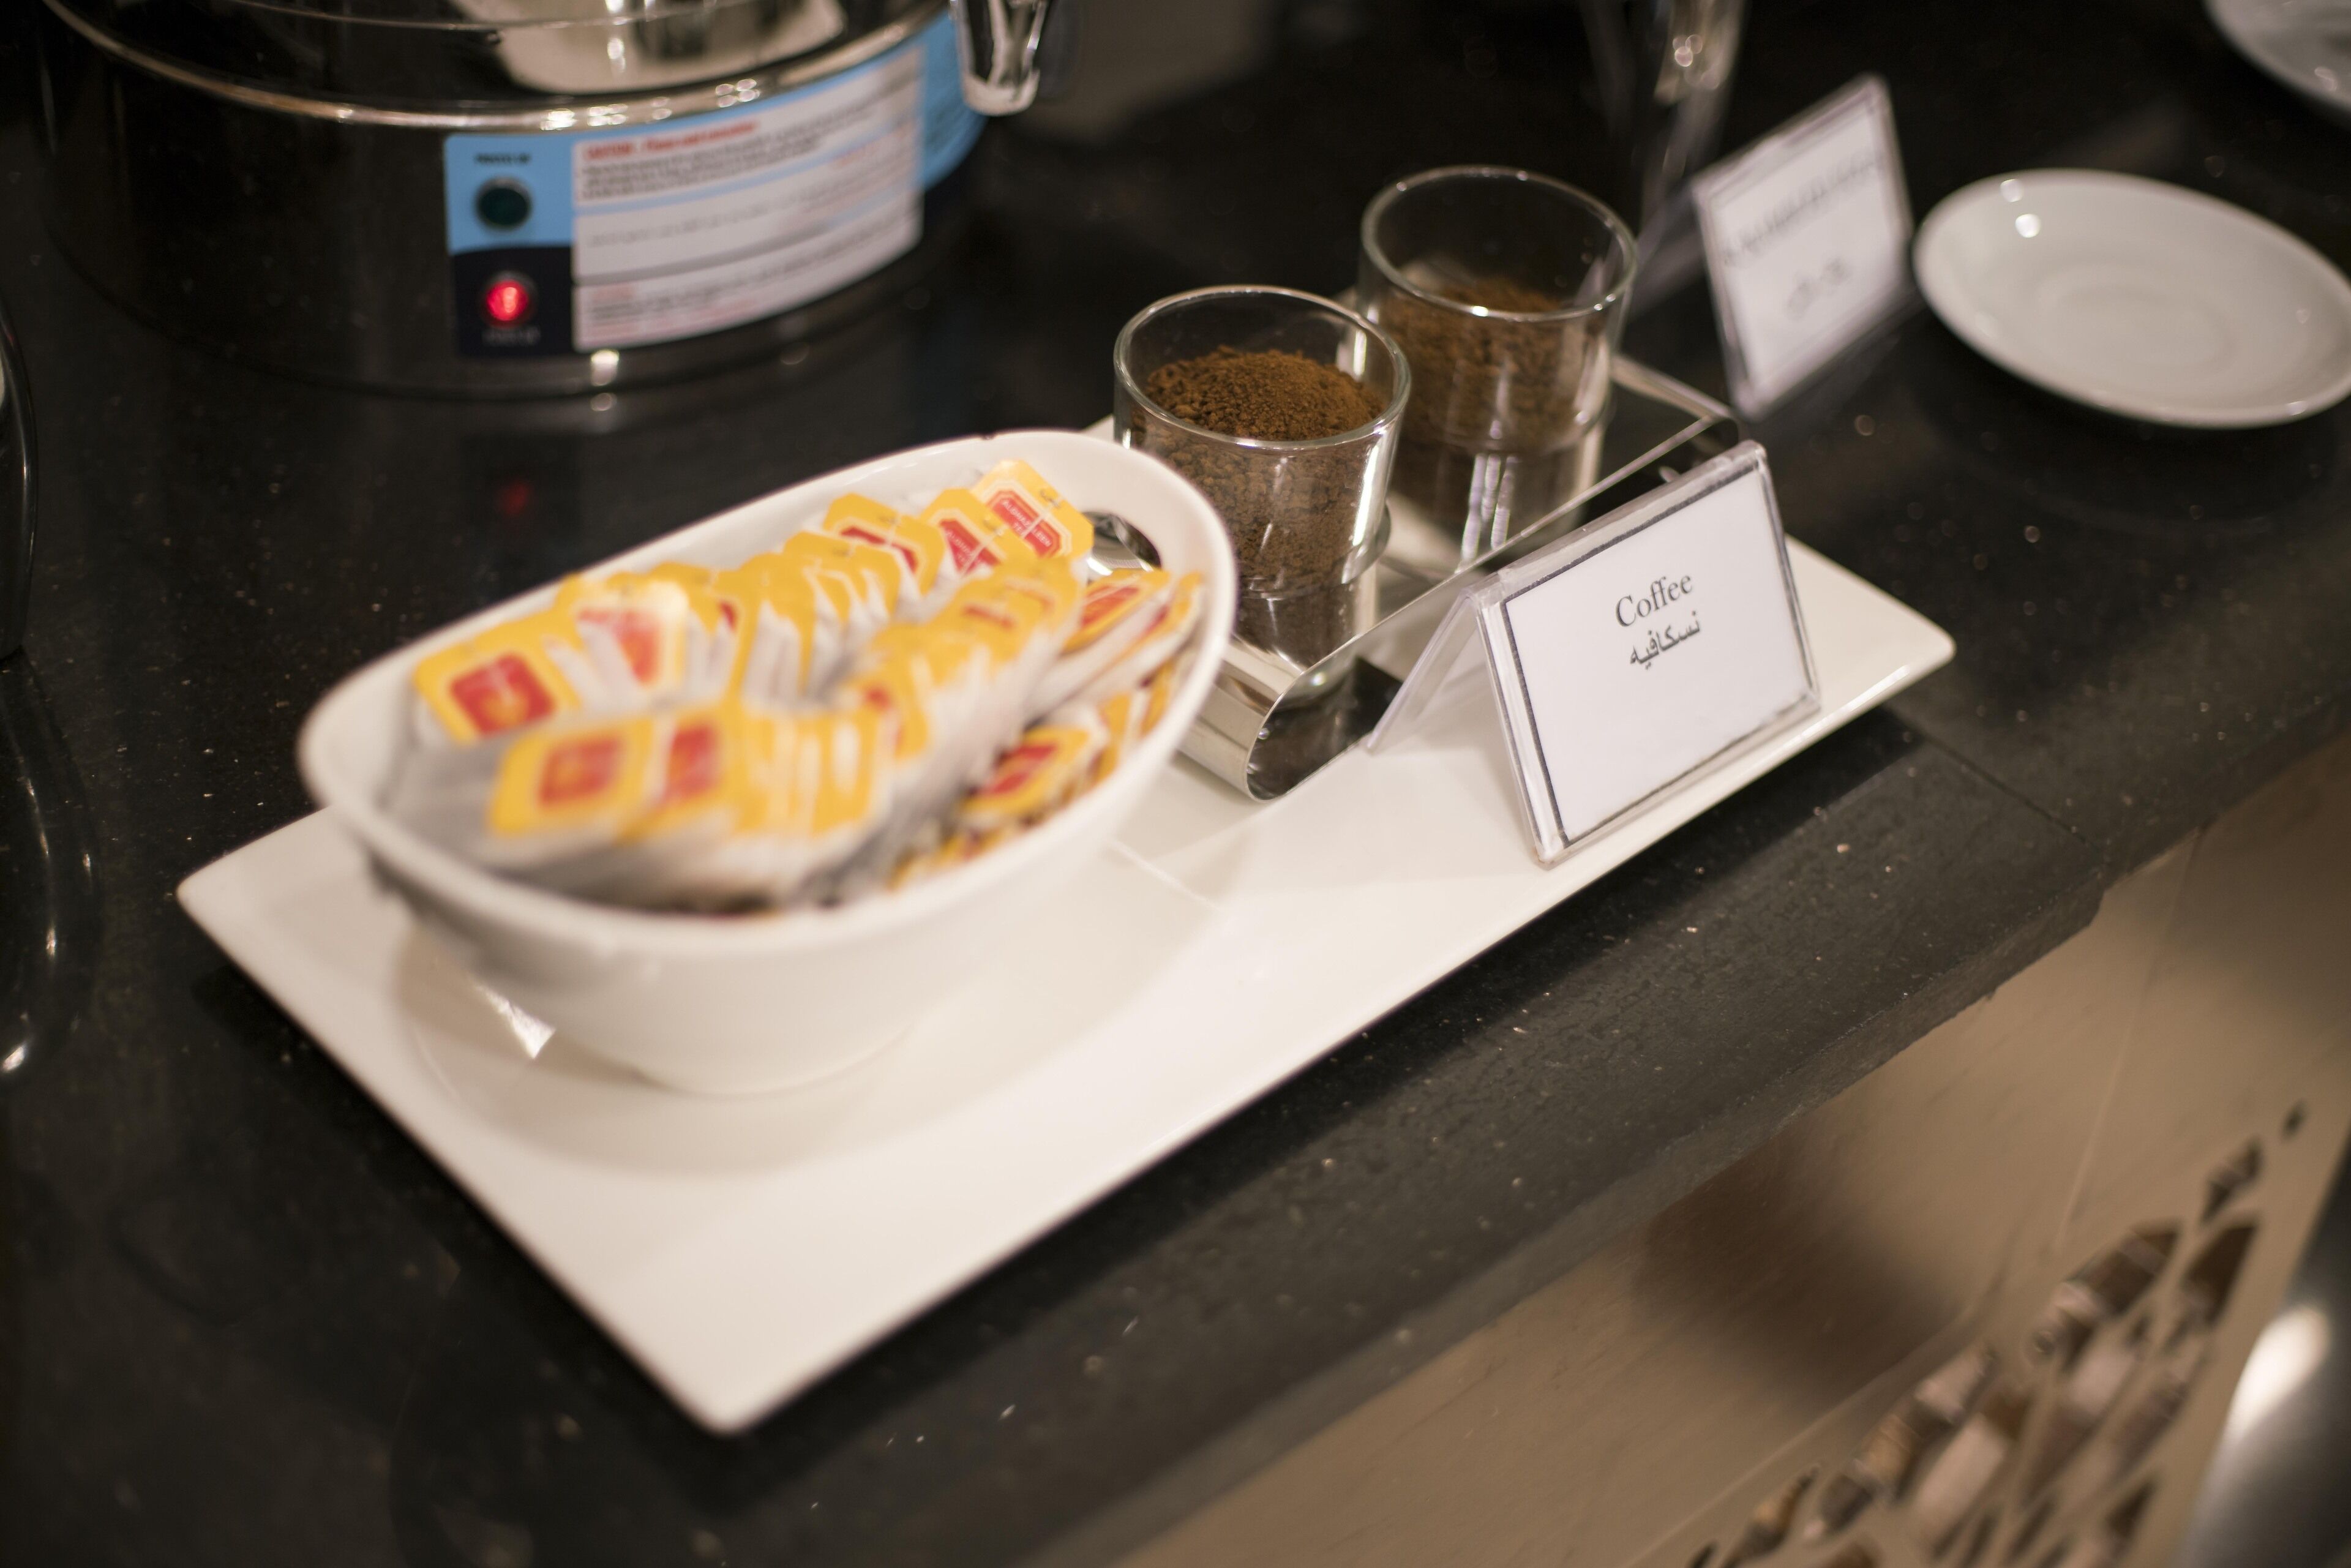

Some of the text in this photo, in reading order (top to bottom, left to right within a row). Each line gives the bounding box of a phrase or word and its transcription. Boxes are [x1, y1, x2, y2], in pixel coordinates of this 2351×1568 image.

[1002, 499, 1051, 547] ALGHAZLEEN
[1615, 575, 1693, 627] Coffee
[1630, 610, 1701, 670] نسكافيه
